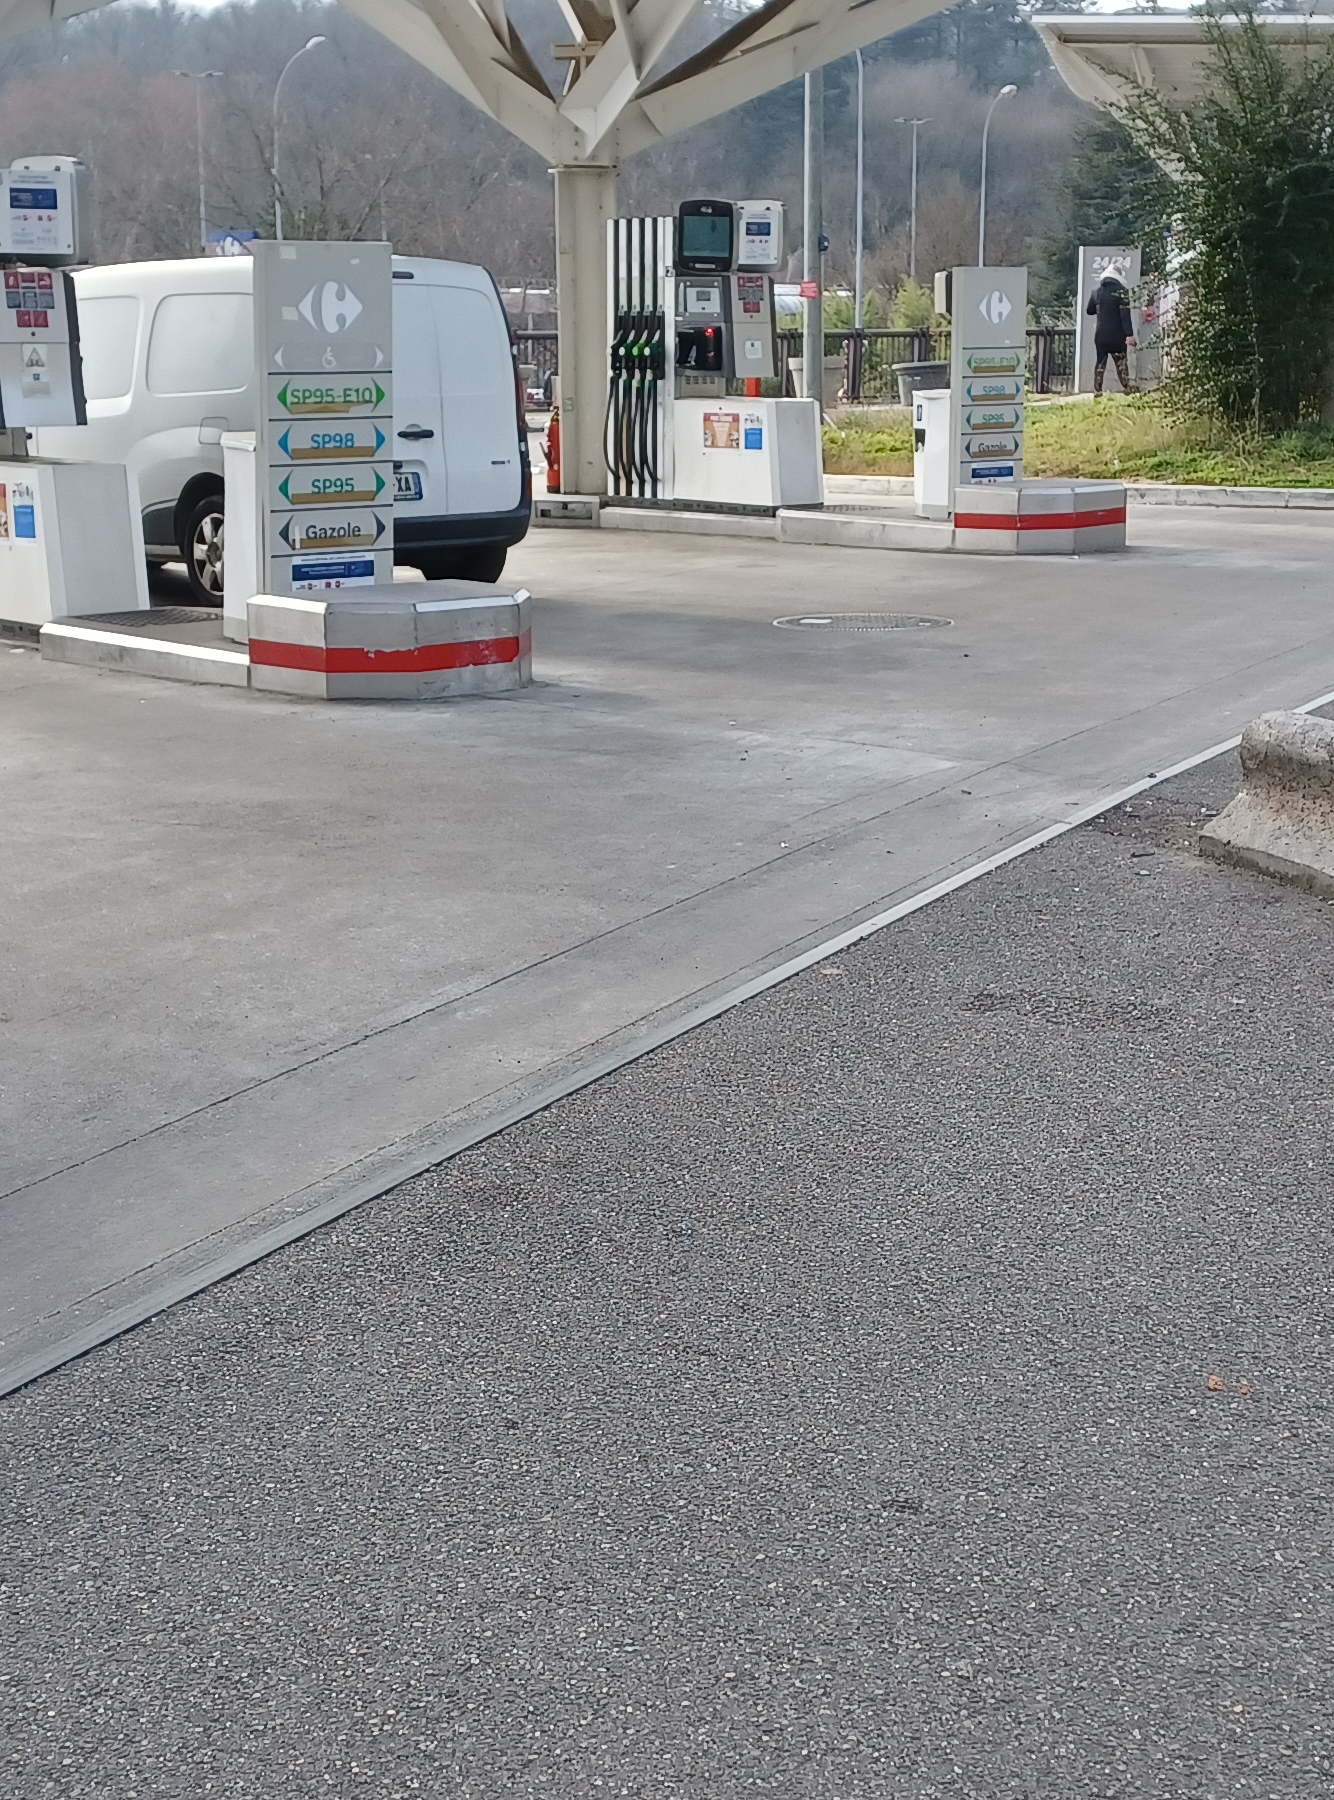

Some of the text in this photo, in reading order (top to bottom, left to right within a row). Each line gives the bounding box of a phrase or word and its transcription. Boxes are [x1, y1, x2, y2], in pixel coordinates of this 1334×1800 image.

[290, 387, 373, 404] SP95-E10
[310, 432, 355, 449] SP98
[311, 477, 355, 494] SP95
[305, 522, 362, 539] Gazole
